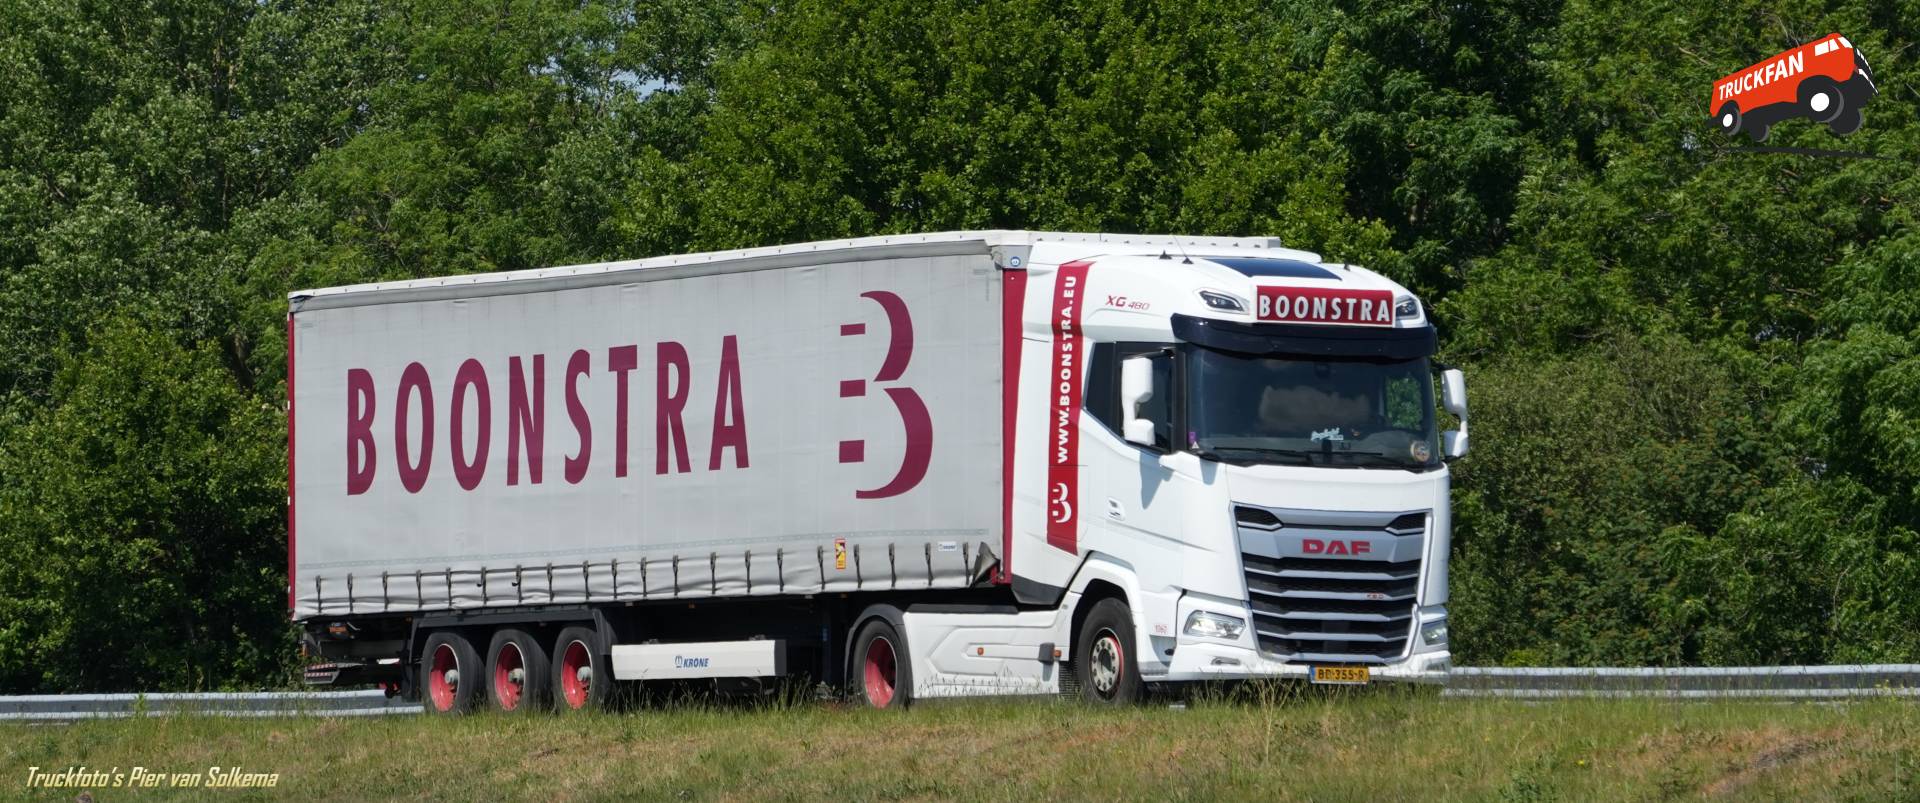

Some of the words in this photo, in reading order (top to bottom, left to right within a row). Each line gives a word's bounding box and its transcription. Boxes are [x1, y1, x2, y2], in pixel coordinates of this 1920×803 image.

[1105, 295, 1127, 307] XG
[1128, 301, 1150, 310] 480
[1258, 294, 1391, 323] BOONSTRA
[1057, 275, 1077, 464] WWW.BOONSTRA.EU
[346, 334, 750, 497] BOONSTRA
[1302, 538, 1372, 556] DAF
[683, 657, 709, 668] KRONE
